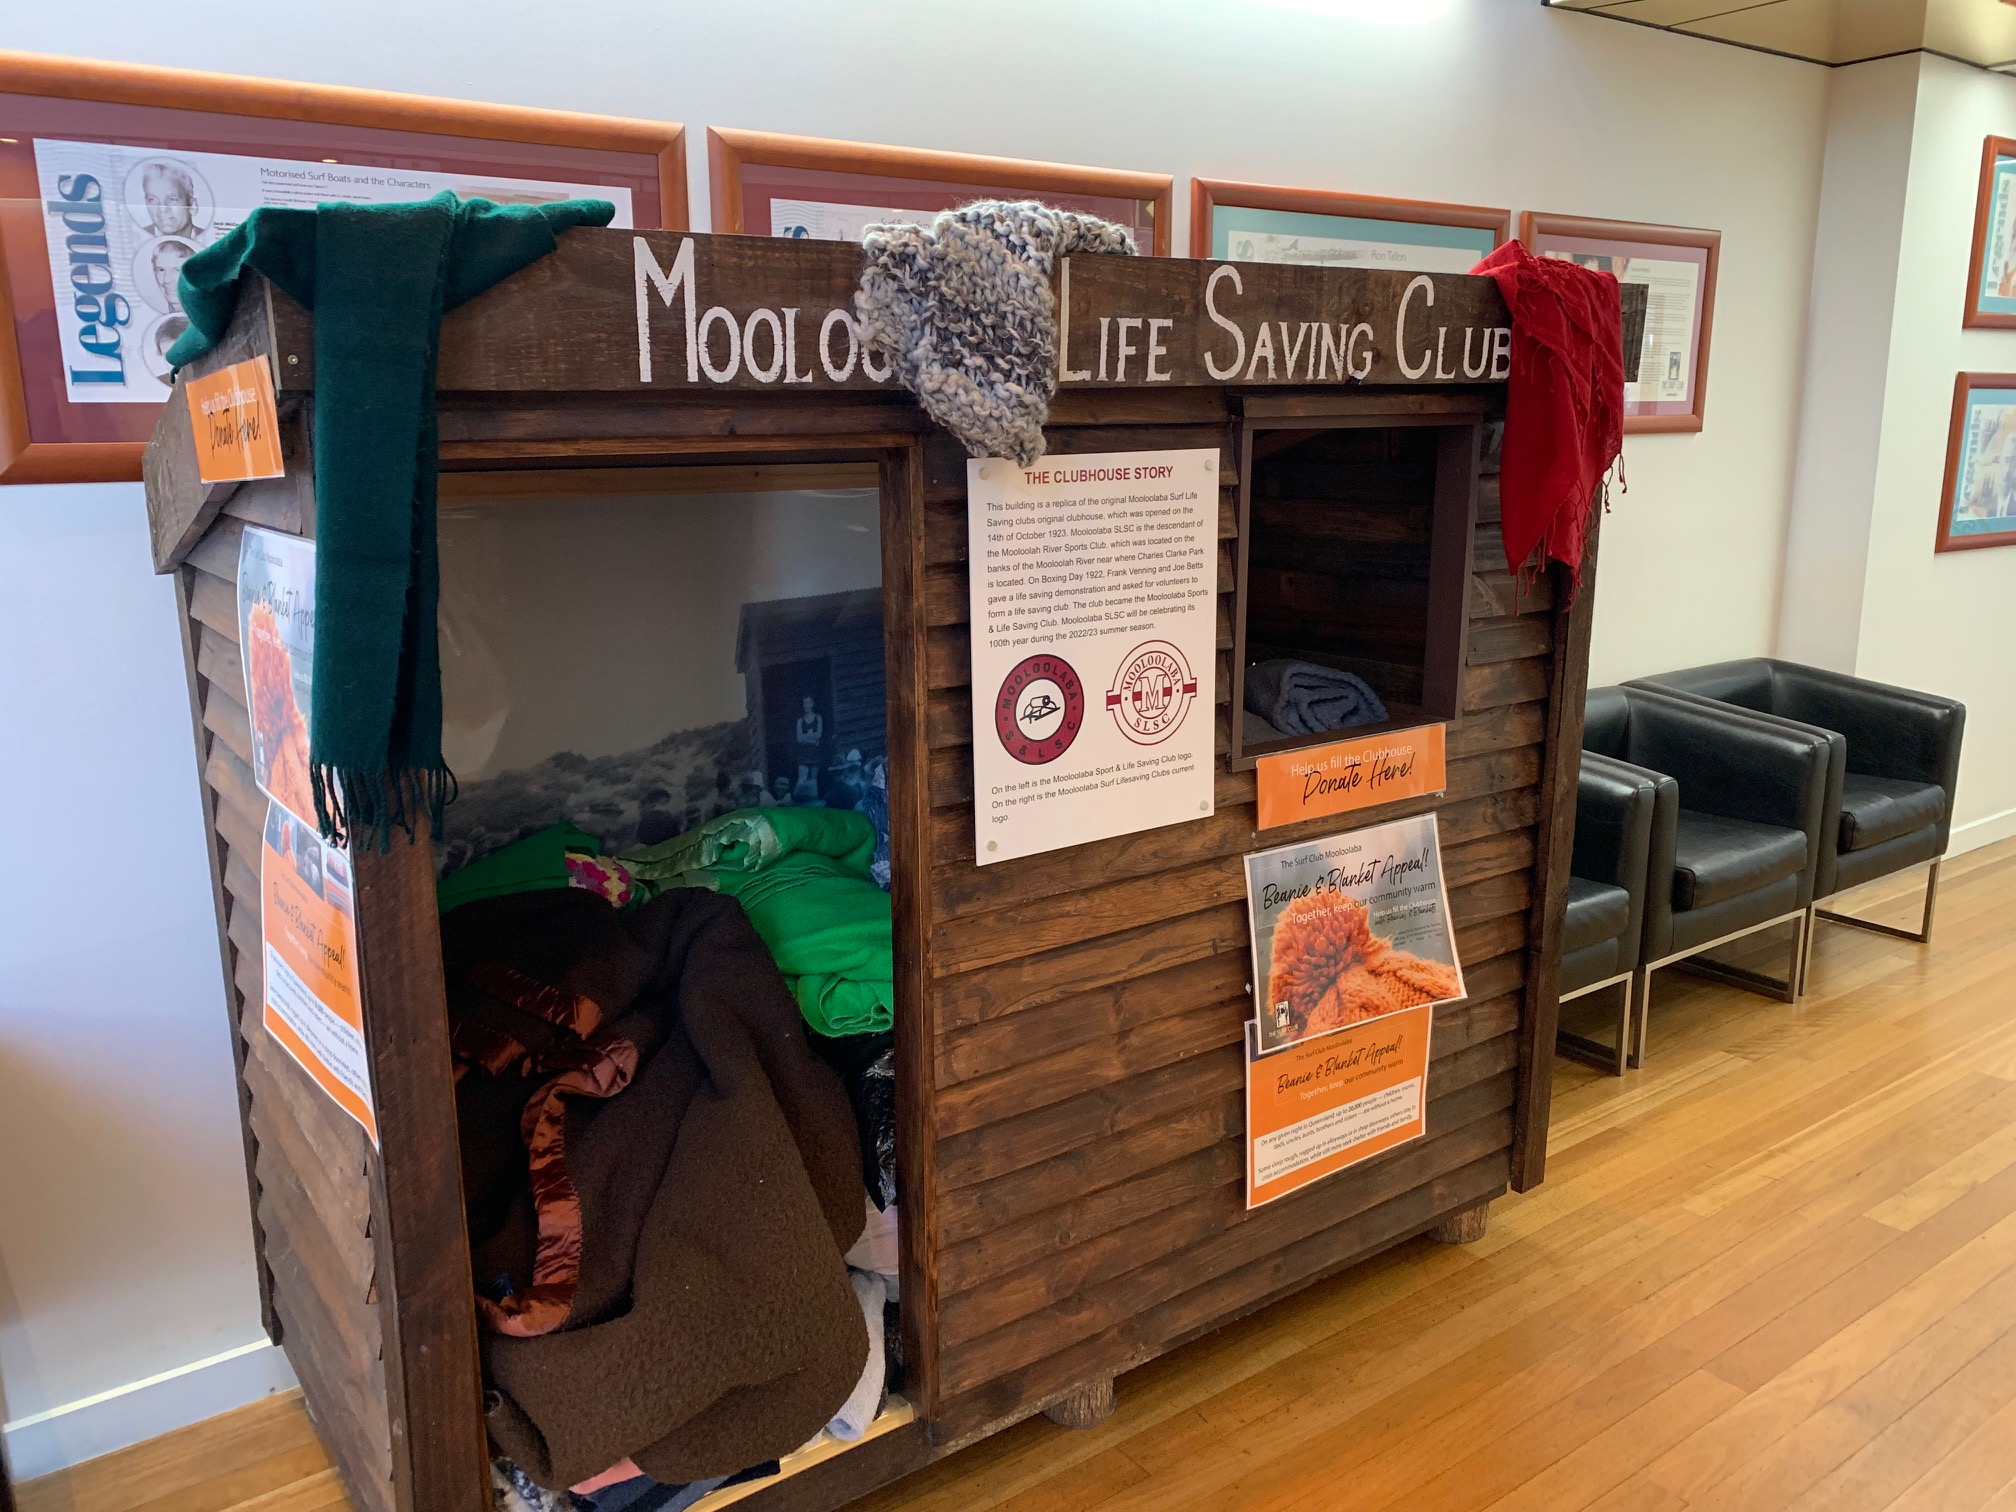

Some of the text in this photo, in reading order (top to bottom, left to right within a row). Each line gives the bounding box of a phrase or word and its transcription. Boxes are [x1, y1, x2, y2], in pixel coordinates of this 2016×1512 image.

[260, 168, 431, 189] Motorised Surf Boats and the Characters
[47, 174, 130, 386] Legends
[1058, 257, 1512, 382] LIFE SAVING CLUB
[1024, 466, 1173, 484] THE CLUBHOUSE STORY
[986, 502, 1003, 510] This
[1005, 501, 1034, 510] building
[1052, 499, 1076, 508] replica
[1078, 497, 1085, 506] of
[1100, 495, 1126, 506] original
[1128, 493, 1168, 502] Mooloolaba
[1169, 492, 1184, 500] Surf
[986, 518, 1013, 527] Saving
[1015, 516, 1035, 526] clubs
[1037, 514, 1064, 525] original
[1066, 512, 1105, 522] clubhouse,
[1107, 510, 1127, 518] which
[1144, 507, 1170, 518] opened
[987, 533, 1004, 542] 14th
[1005, 532, 1014, 542] of
[1015, 530, 1045, 540] October
[1048, 528, 1068, 538] 1923.
[1070, 526, 1111, 536] Mooloolaba
[1113, 524, 1134, 533] SLSC
[1156, 520, 1194, 530] descendant
[1196, 519, 1203, 527] of
[987, 563, 1010, 572] banks
[1012, 562, 1020, 570] of
[1021, 561, 1034, 570] the
[1036, 558, 1073, 568] Mooloolah
[1075, 557, 1094, 566] River
[1137, 551, 1163, 560] Charles
[1165, 549, 1187, 557] Clarke
[1001, 546, 1040, 556] Mooloolah
[1042, 545, 1062, 553] River
[1064, 542, 1087, 553] Sports
[1089, 540, 1108, 549] Club,
[1109, 539, 1130, 547] which
[1147, 536, 1172, 545] located
[996, 577, 1025, 587] located.
[1027, 576, 1039, 584] On
[1041, 574, 1066, 583] Boxing
[1068, 572, 1083, 581] Day
[1085, 570, 1104, 579] 1922,
[1106, 568, 1127, 577] Frank
[1128, 566, 1156, 574] Venning
[1158, 564, 1171, 572] and
[1186, 561, 1203, 570] Betts
[989, 638, 1010, 647] 100th
[1011, 637, 1028, 647] year
[1030, 634, 1053, 643] during
[1068, 627, 1097, 638] 2022/23
[1099, 626, 1127, 635] summer
[1129, 622, 1157, 631] season.
[1124, 654, 1180, 692] MOOLOOLABA
[1138, 674, 1166, 712] M
[1134, 712, 1170, 732] SLSC
[1018, 780, 1029, 789] left
[1052, 770, 1093, 783] Mooloolaba
[1095, 765, 1113, 775] Sport
[1122, 761, 1134, 770] Life
[1136, 758, 1159, 767] Saving
[1160, 754, 1176, 763] Club
[1177, 752, 1194, 760] logo.
[1292, 744, 1412, 777] Help us fill the Clubhouse
[991, 800, 1003, 808] On
[1018, 794, 1034, 804] right
[1058, 782, 1098, 795] Mooloolaba
[1100, 778, 1114, 788] Surf
[1115, 773, 1149, 784] Lifesaving
[1151, 769, 1170, 778] Clubs
[1171, 764, 1194, 774] current
[1303, 752, 1416, 805] Donate Here!
[992, 814, 1010, 823] logo.
[1281, 844, 1362, 870] The Surf Club Mooloolaba
[1263, 883, 1311, 910] Beanie
[1316, 875, 1324, 896] &
[1327, 859, 1381, 894] Blanket
[1291, 882, 1436, 925] Together, keep our community warm
[1278, 1072, 1313, 1094] Beanie
[1325, 1047, 1365, 1077] Blanket
[1329, 1080, 1343, 1091] keep
[1344, 1076, 1354, 1084] our
[1355, 1066, 1387, 1081] community
[1388, 1058, 1403, 1069] warm
